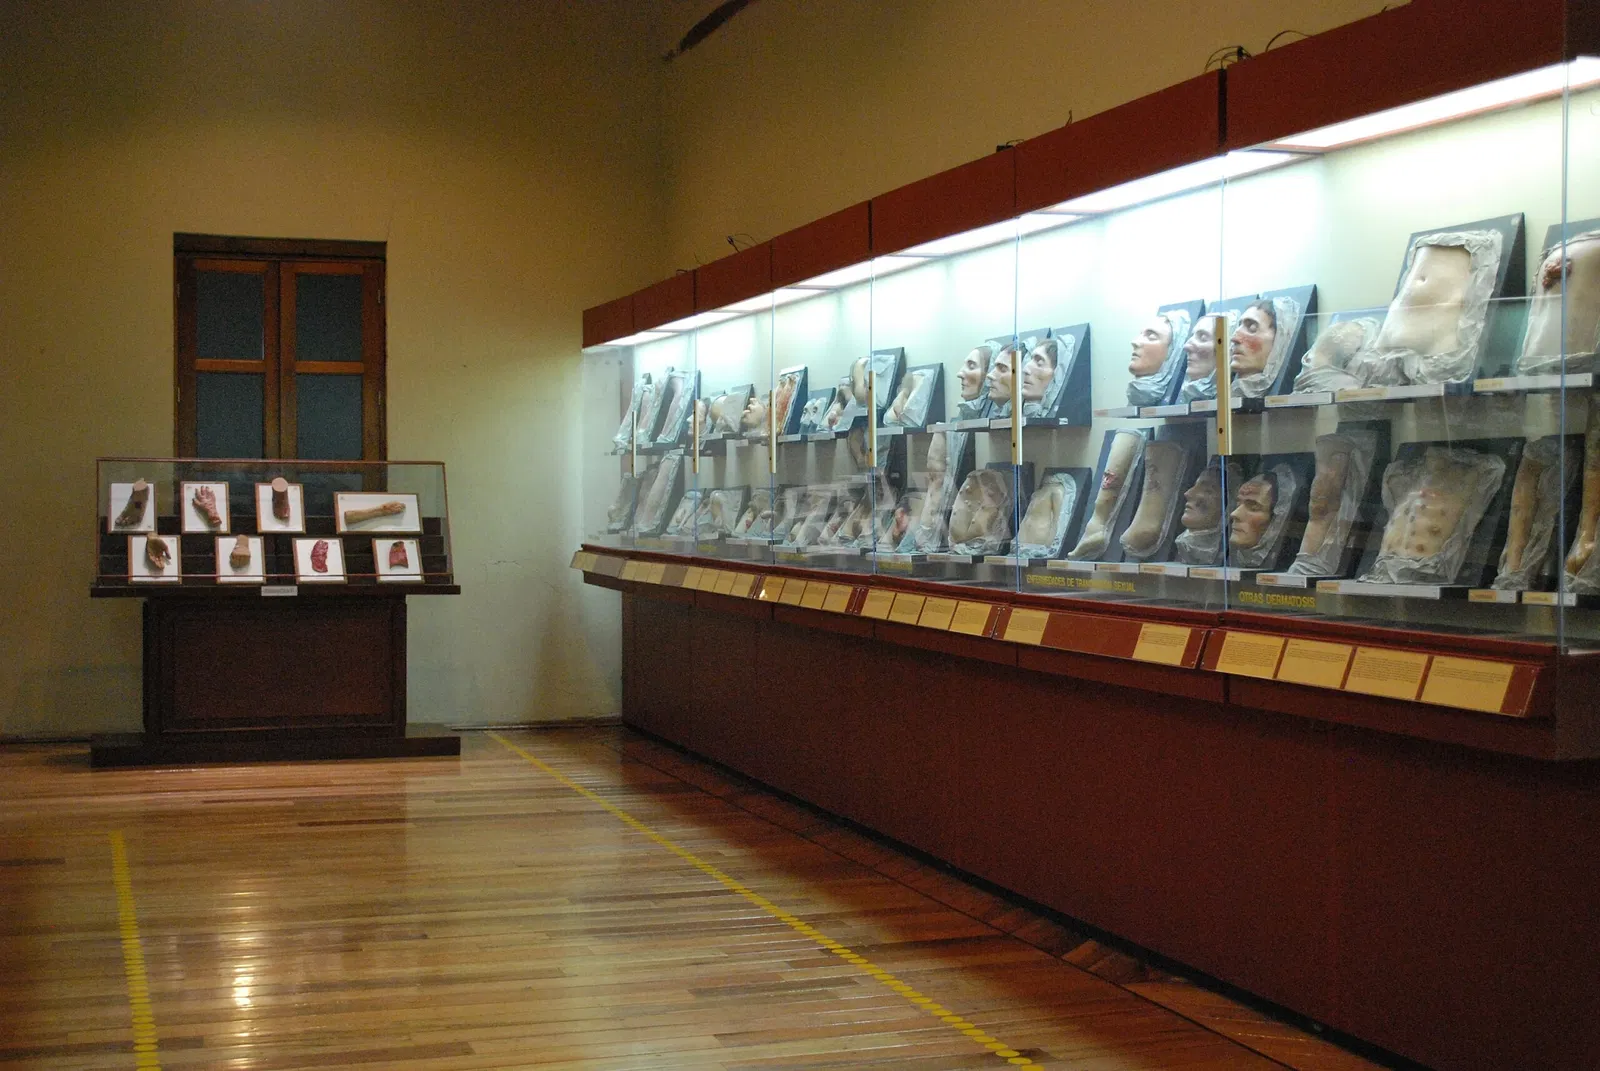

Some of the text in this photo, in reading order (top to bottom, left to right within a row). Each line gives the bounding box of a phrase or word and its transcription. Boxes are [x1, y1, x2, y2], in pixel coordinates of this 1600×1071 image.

[1067, 577, 1075, 587] DE
[1239, 591, 1316, 608] OTRAS DERMATOSIS
